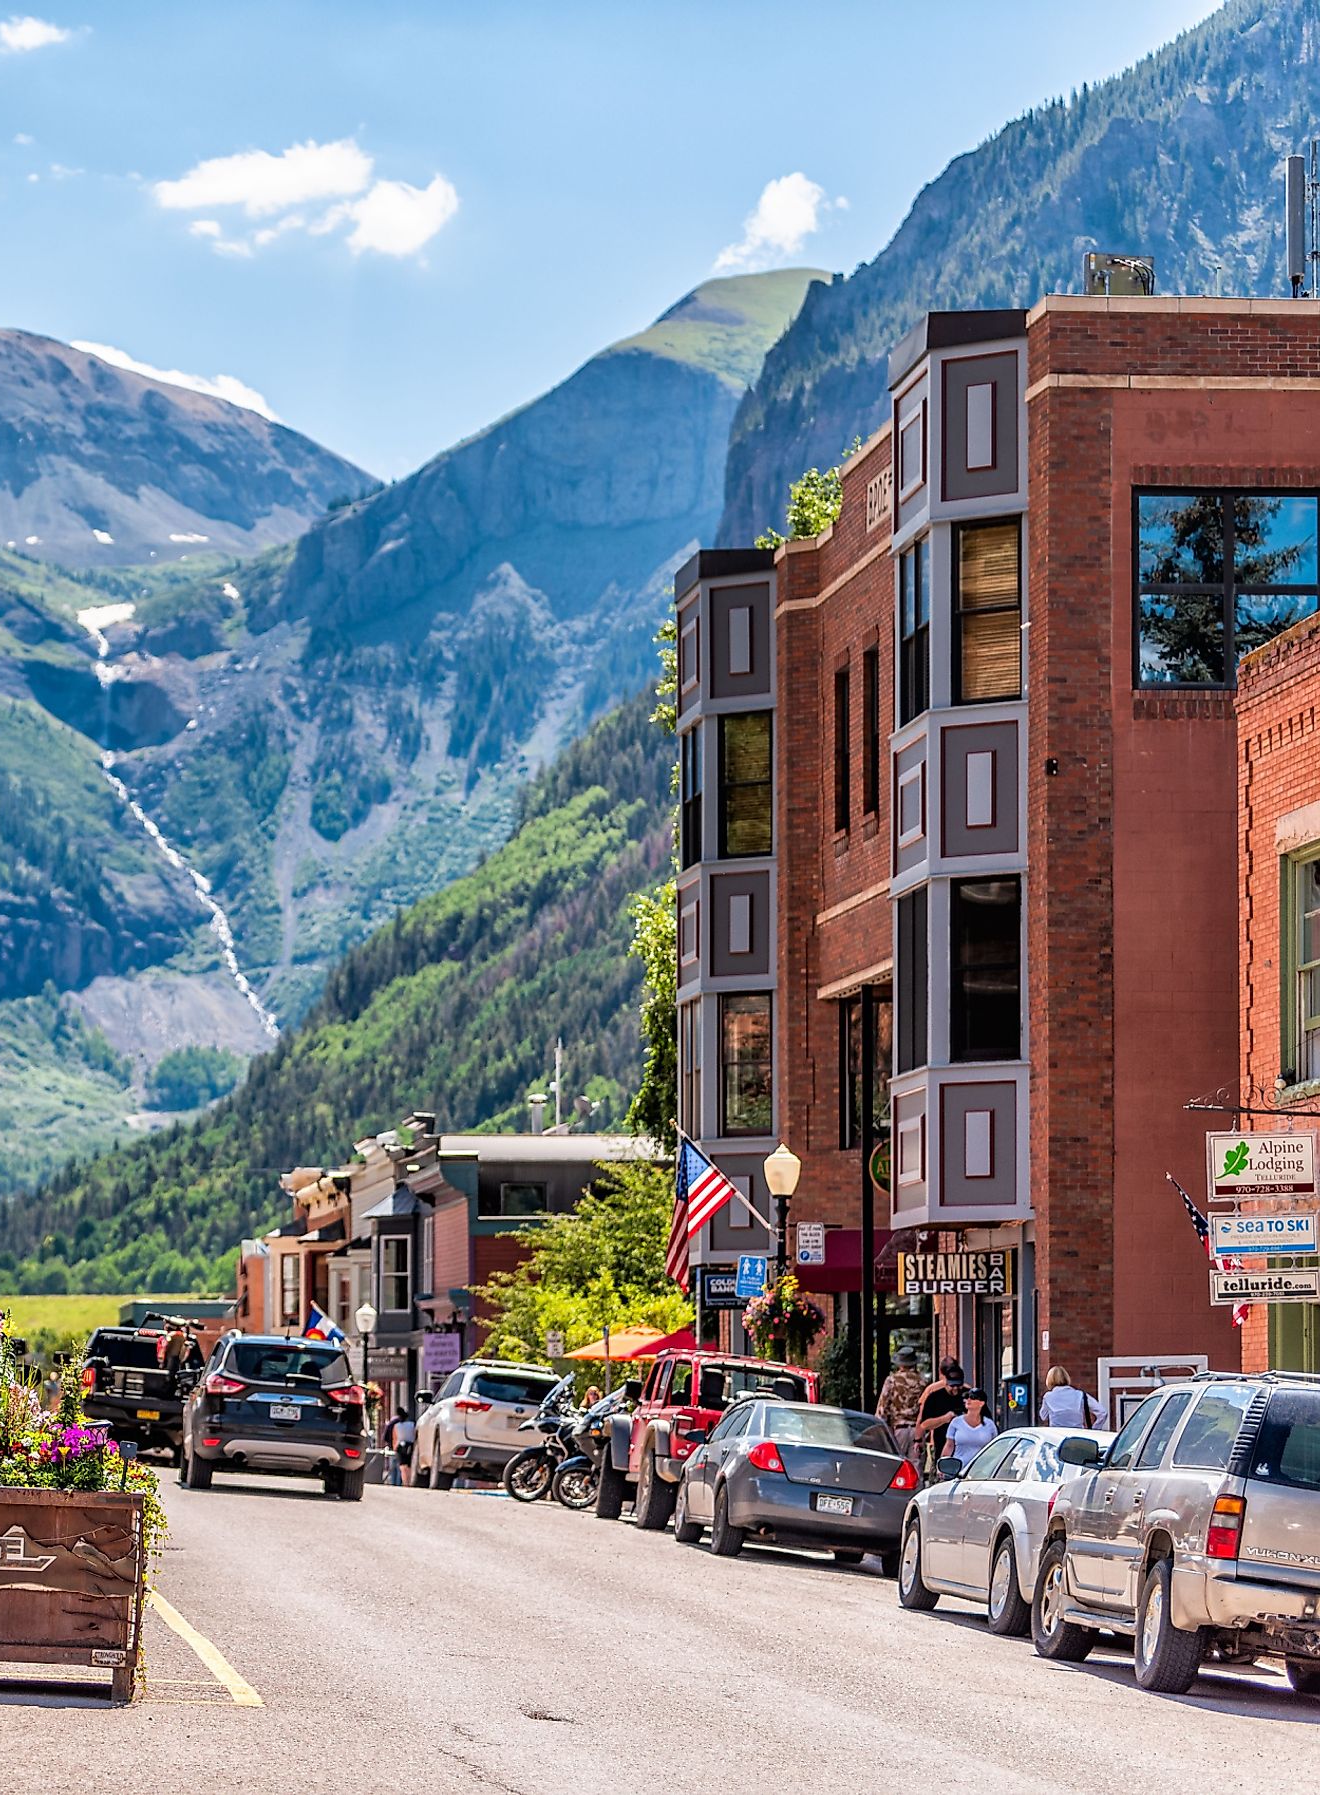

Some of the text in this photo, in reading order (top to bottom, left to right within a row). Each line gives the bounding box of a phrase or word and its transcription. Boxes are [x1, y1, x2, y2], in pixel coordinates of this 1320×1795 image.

[1258, 1141, 1304, 1156] Alpine
[1249, 1157, 1304, 1172] Lodging
[1236, 1185, 1294, 1193] 970-728-3388
[1236, 1219, 1309, 1233] sea TO SKI
[905, 1254, 987, 1280] STEAMIES
[710, 1278, 735, 1286] COLD
[906, 1281, 1004, 1293] BURGER
[1223, 1277, 1312, 1291] telluride.com
[1015, 1386, 1025, 1402] P
[1246, 1546, 1300, 1562] YUKON
